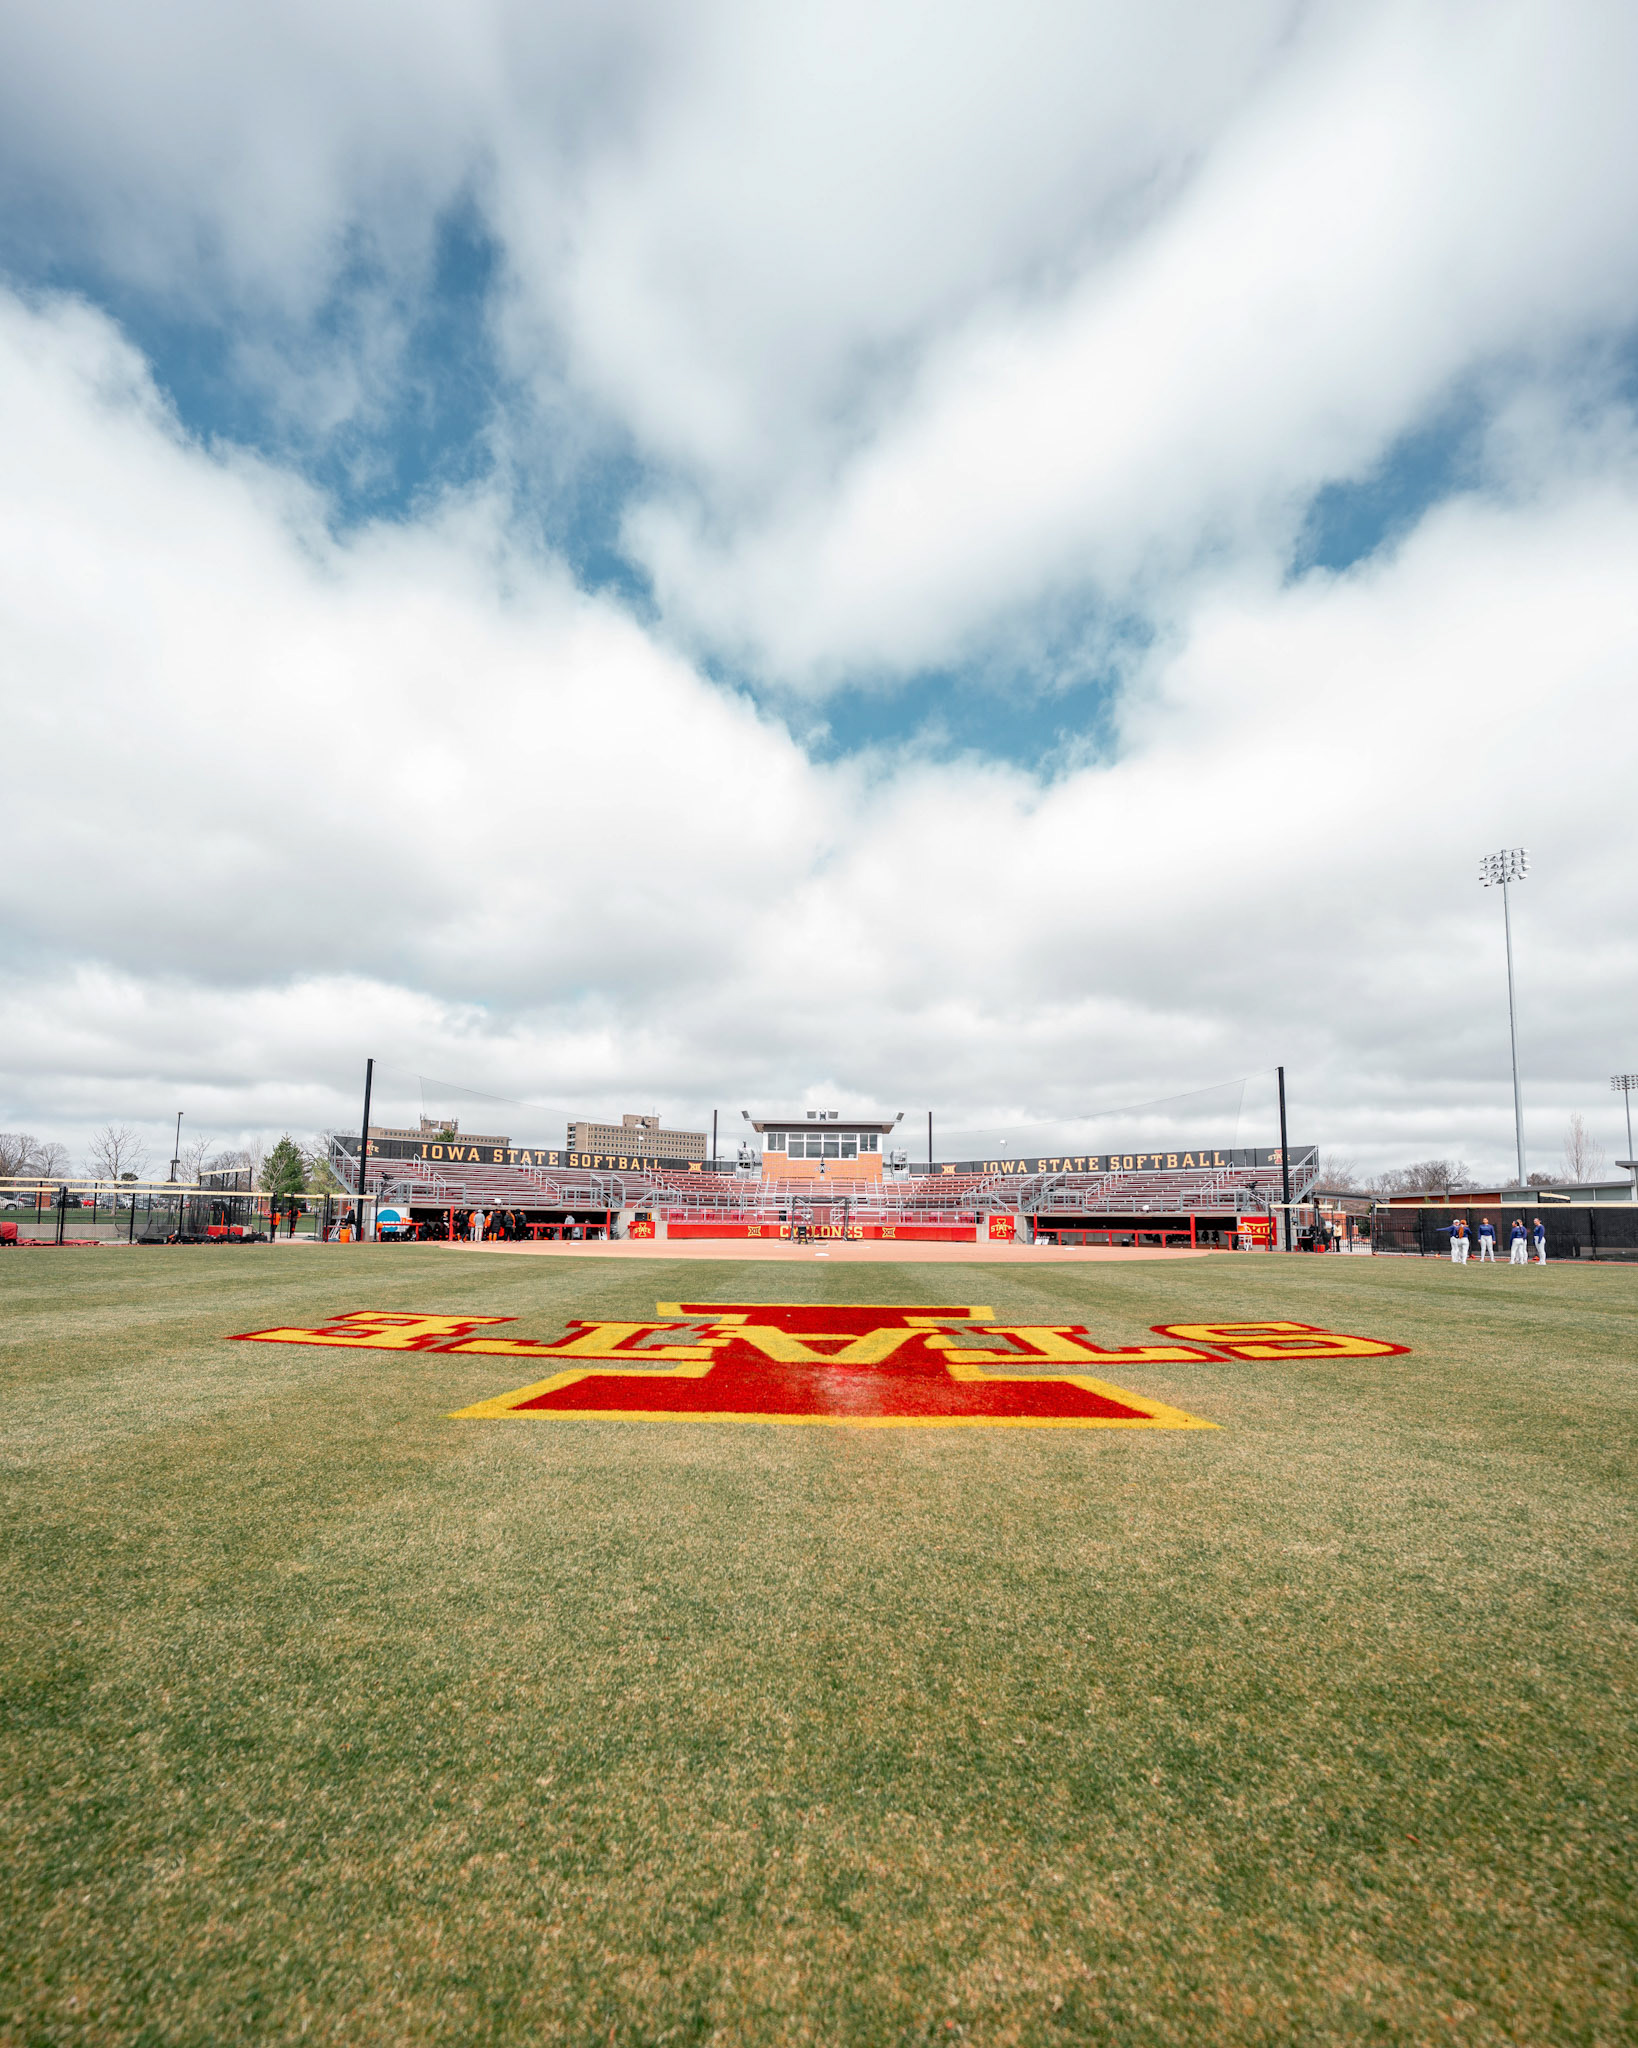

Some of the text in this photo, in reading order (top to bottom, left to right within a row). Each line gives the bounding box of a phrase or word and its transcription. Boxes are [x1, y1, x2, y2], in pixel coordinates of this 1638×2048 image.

[421, 1144, 662, 1170] IOWA STATE SOFTBALL
[983, 1152, 1225, 1174] IOWA STATE SOFTBALL
